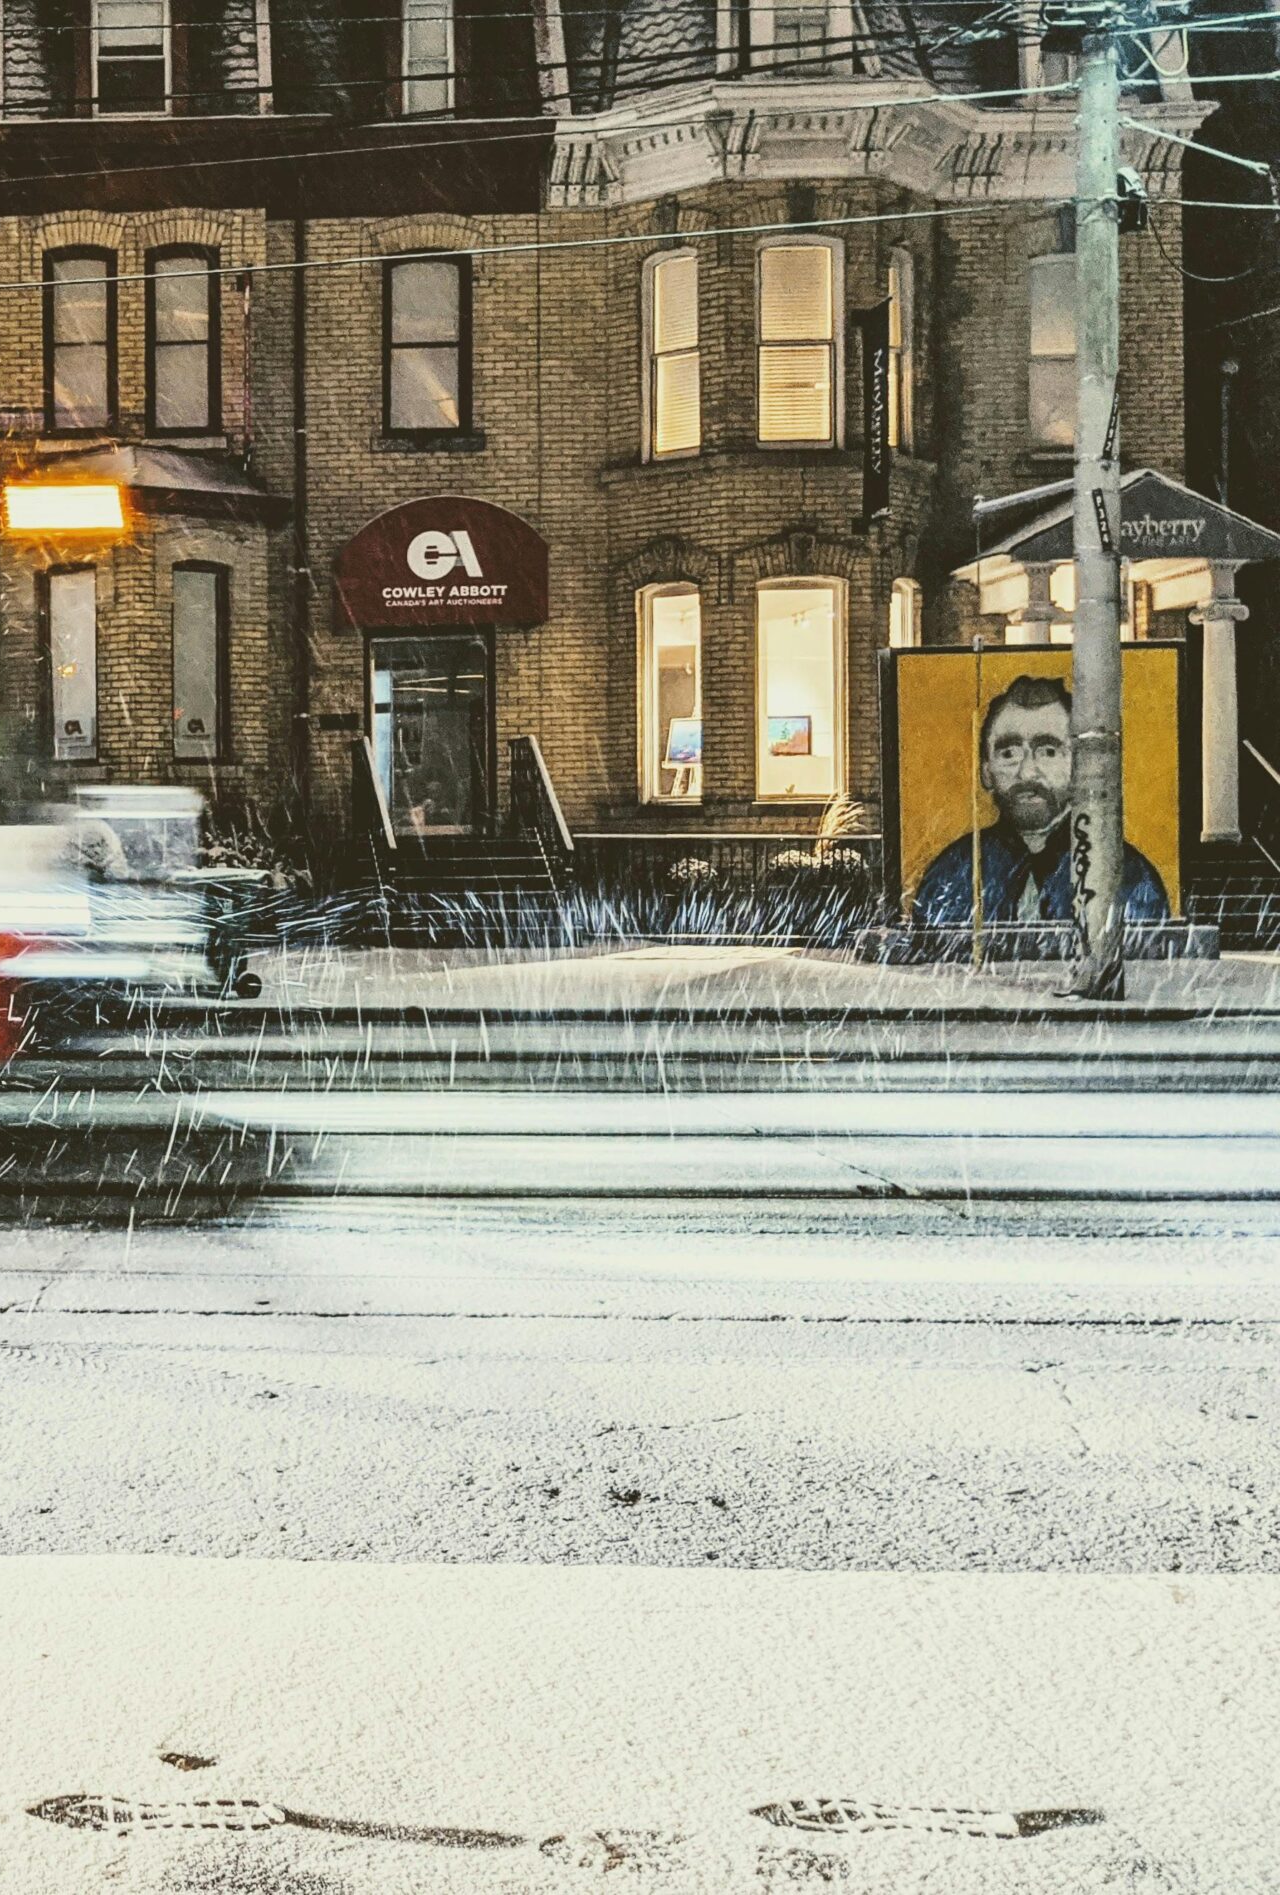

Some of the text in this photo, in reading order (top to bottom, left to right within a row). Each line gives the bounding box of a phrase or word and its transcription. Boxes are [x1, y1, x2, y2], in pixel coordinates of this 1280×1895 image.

[1120, 513, 1206, 543] ayberry
[382, 585, 508, 599] COWLEY ABBOTT
[385, 599, 426, 608] CANADA'S
[446, 597, 503, 606] AUCTIONEERS
